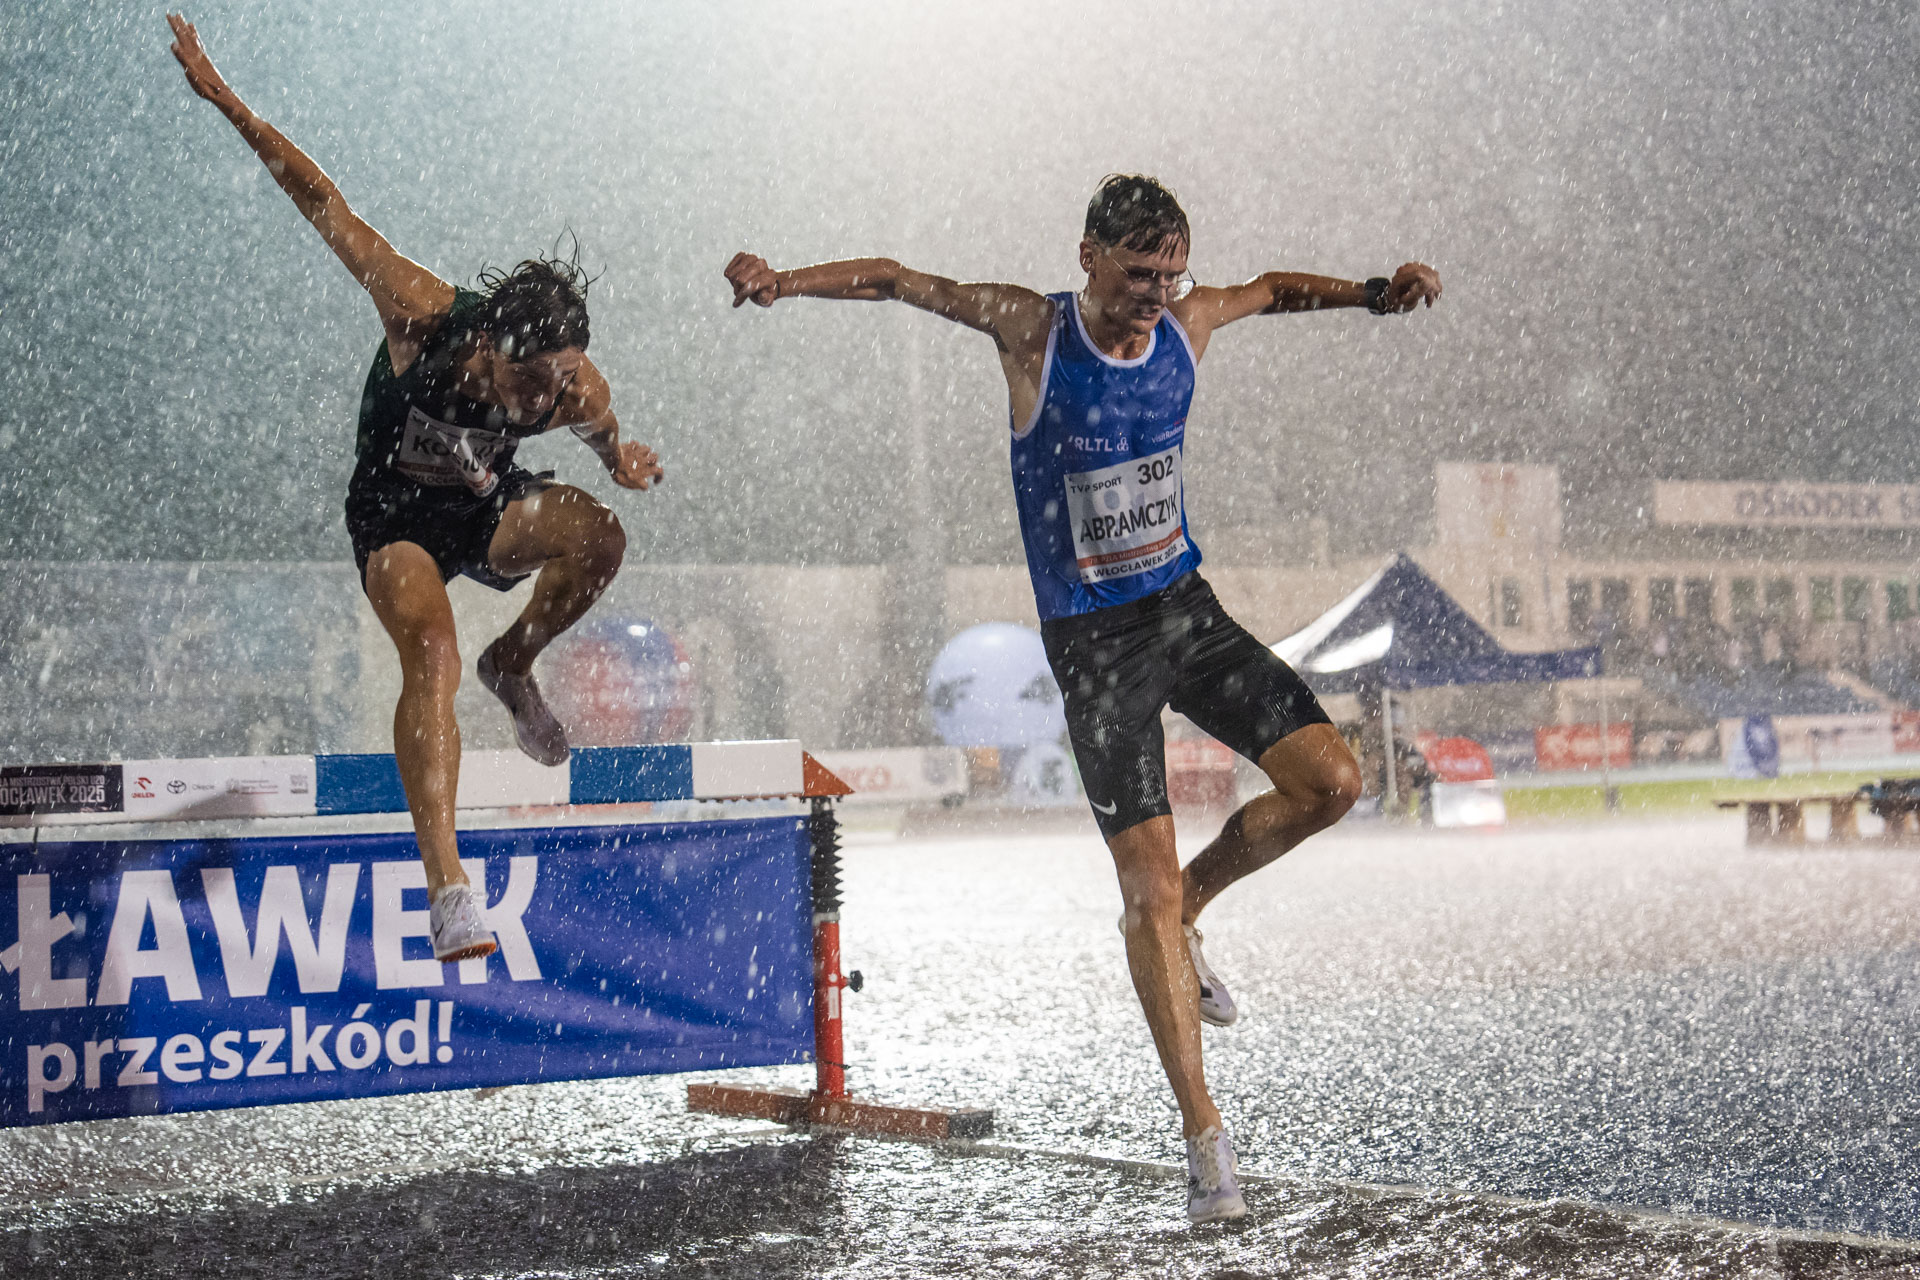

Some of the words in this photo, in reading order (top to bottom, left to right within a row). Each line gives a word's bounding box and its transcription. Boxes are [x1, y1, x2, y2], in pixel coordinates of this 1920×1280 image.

[1074, 436, 1113, 452] RLTL
[1136, 454, 1174, 485] 302
[1070, 484, 1091, 494] TVP
[1092, 476, 1122, 492] SPORT
[1080, 491, 1178, 543] ABRAMCZYK
[1093, 553, 1163, 578] WŁOCŁAWEK
[9, 776, 61, 787] MISTRZOSTWA
[69, 785, 106, 804] 2025
[0, 855, 543, 1011] ŁAWEK
[27, 999, 455, 1114] przeszkód!
